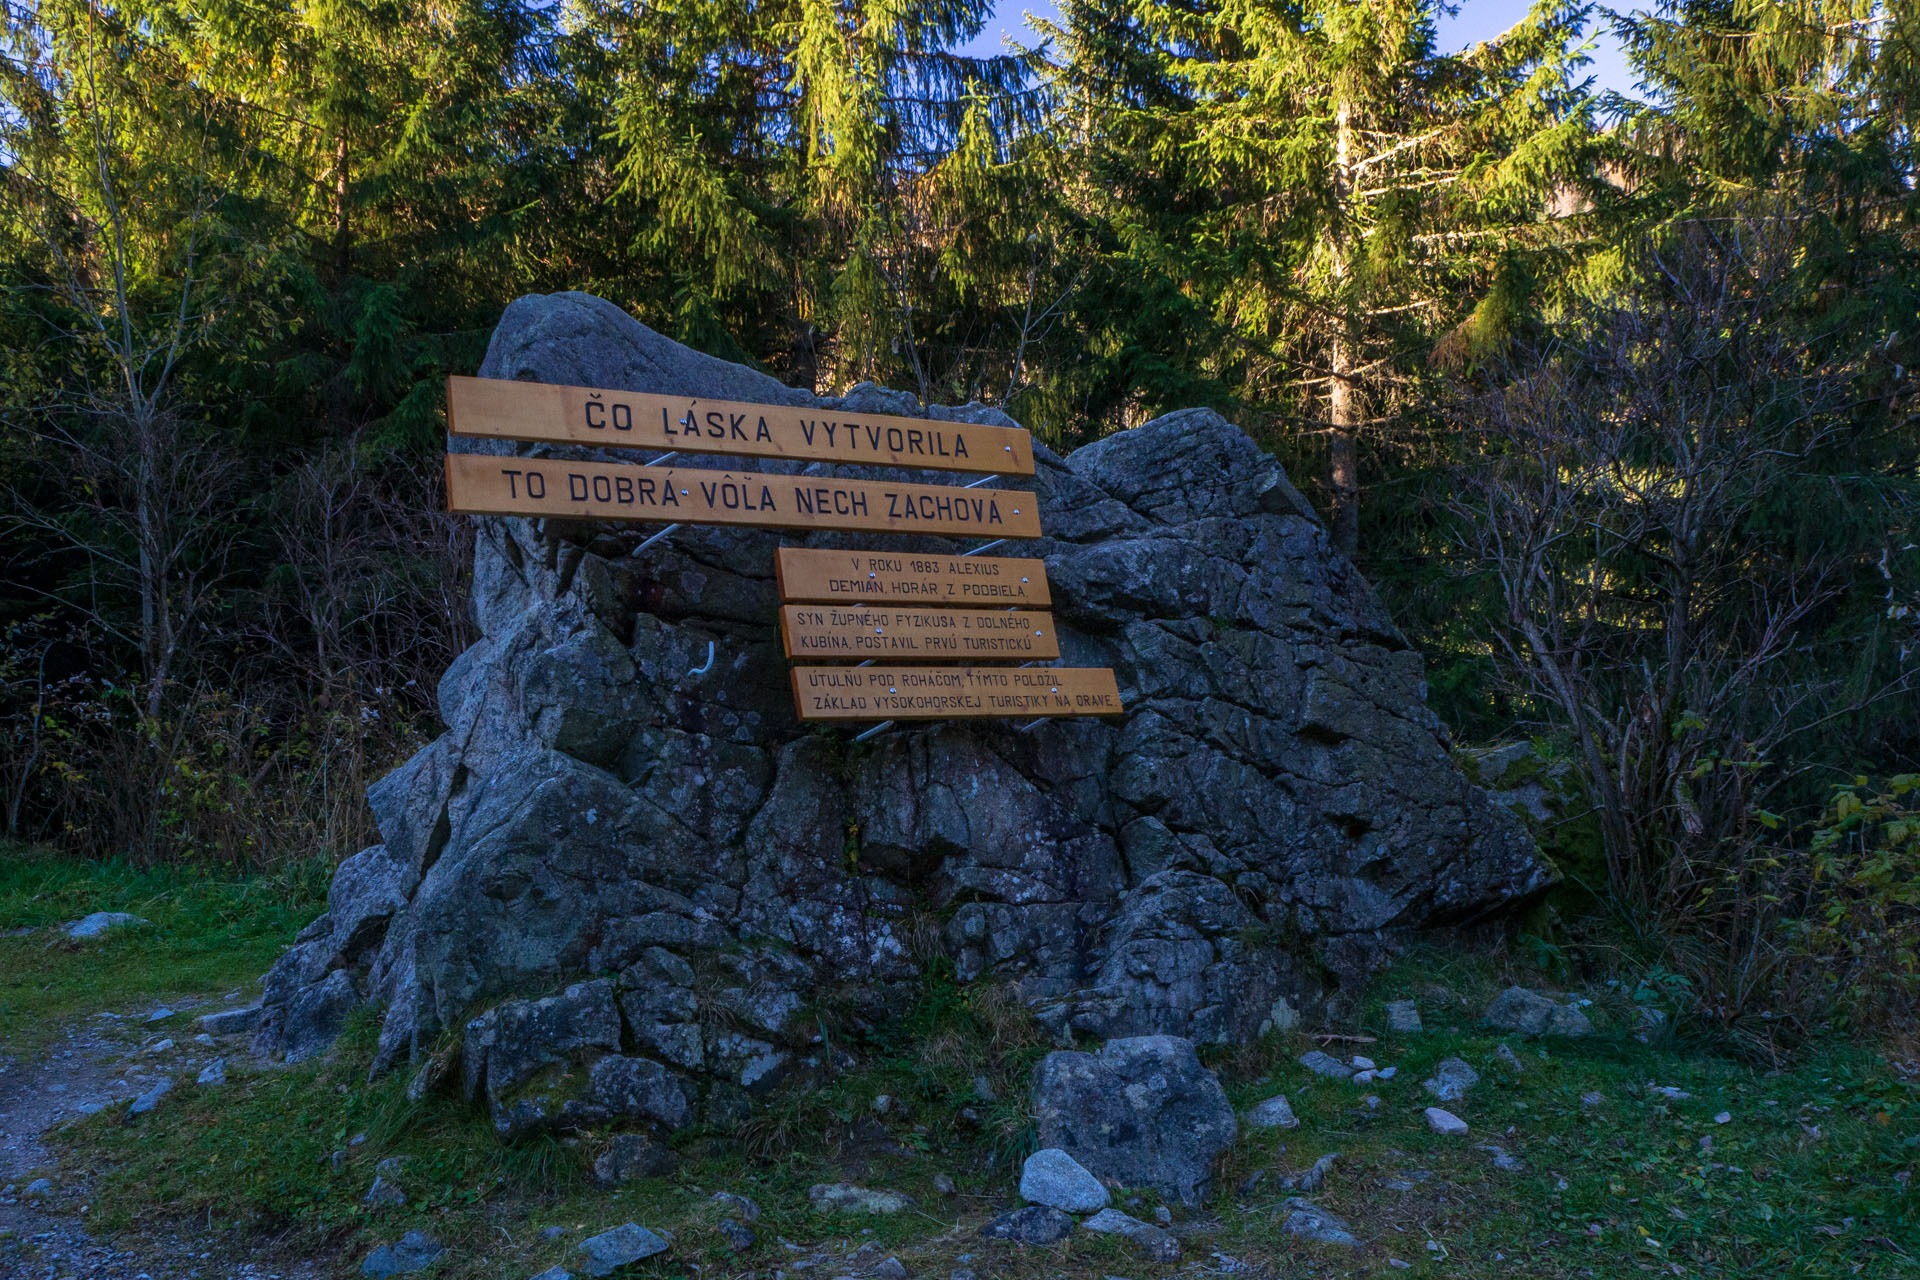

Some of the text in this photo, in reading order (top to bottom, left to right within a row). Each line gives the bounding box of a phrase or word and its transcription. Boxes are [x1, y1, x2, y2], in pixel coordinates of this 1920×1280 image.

[584, 392, 970, 459] ČO LÁSKA VYTVORILA
[501, 469, 546, 500] TO
[568, 470, 680, 508] DOBRÁ
[794, 487, 869, 517] NECH
[884, 492, 1003, 525] ZACHOVÁ
[851, 557, 1000, 576] V ROKU 1883 ALEXIUS
[892, 577, 938, 595] HORÁR
[947, 583, 956, 595] Z
[798, 609, 1030, 629] SYN ŽUPNÉHO FYZIKUSA Z DOLNÉHO
[856, 636, 919, 650] POSTAVIL
[925, 634, 957, 650] PRVÚ
[963, 634, 1032, 650] TURISTICKÚ
[809, 669, 862, 687] ÚTULŇU
[869, 674, 895, 686] POD
[968, 670, 1008, 687] TÝMTO
[1014, 670, 1063, 687] POLOŽIL
[813, 693, 866, 710] ZÁKLAD
[874, 696, 981, 709] VYSOKOHORSKEJ
[988, 695, 1048, 708] TURISTIKY
[1055, 695, 1071, 707] NA
